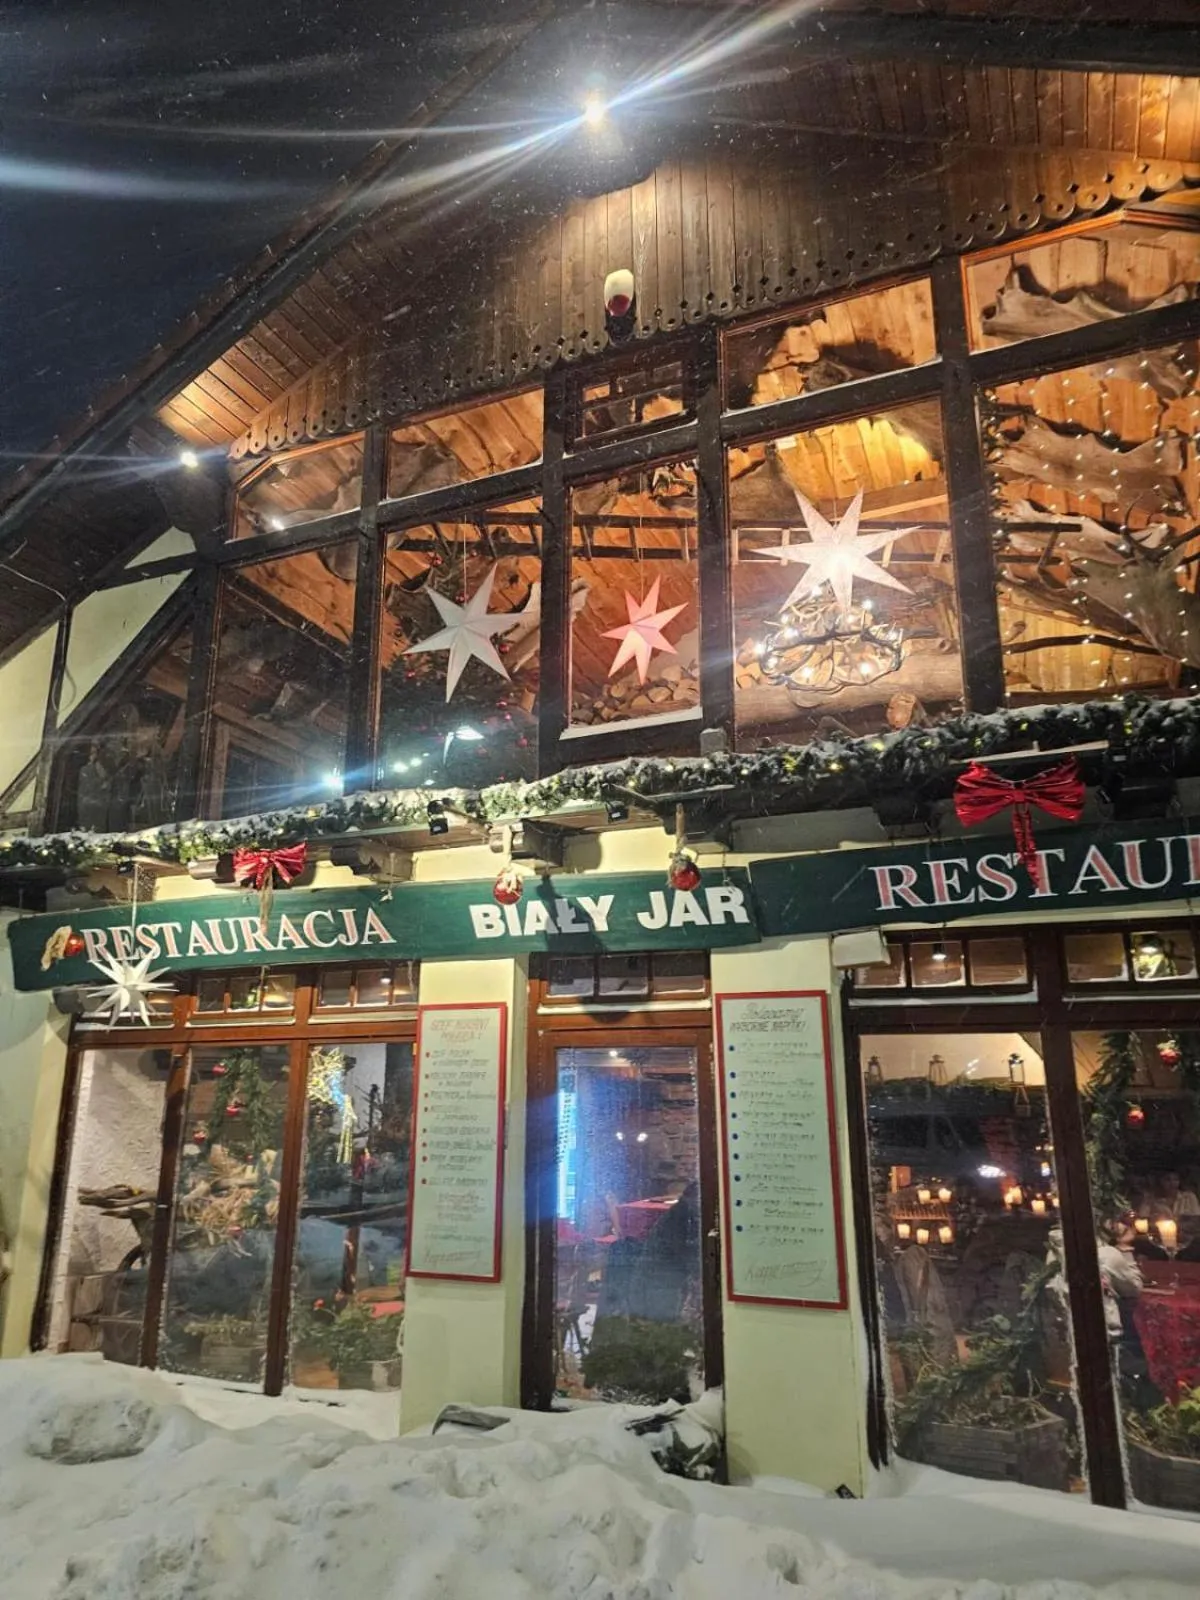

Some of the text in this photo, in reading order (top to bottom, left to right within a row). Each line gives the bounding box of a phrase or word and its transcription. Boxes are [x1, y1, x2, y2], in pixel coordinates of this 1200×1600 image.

[868, 833, 1200, 911] RESTAU
[78, 906, 397, 963] RESTAURACJA
[469, 885, 750, 938] BIAŁY JAR
